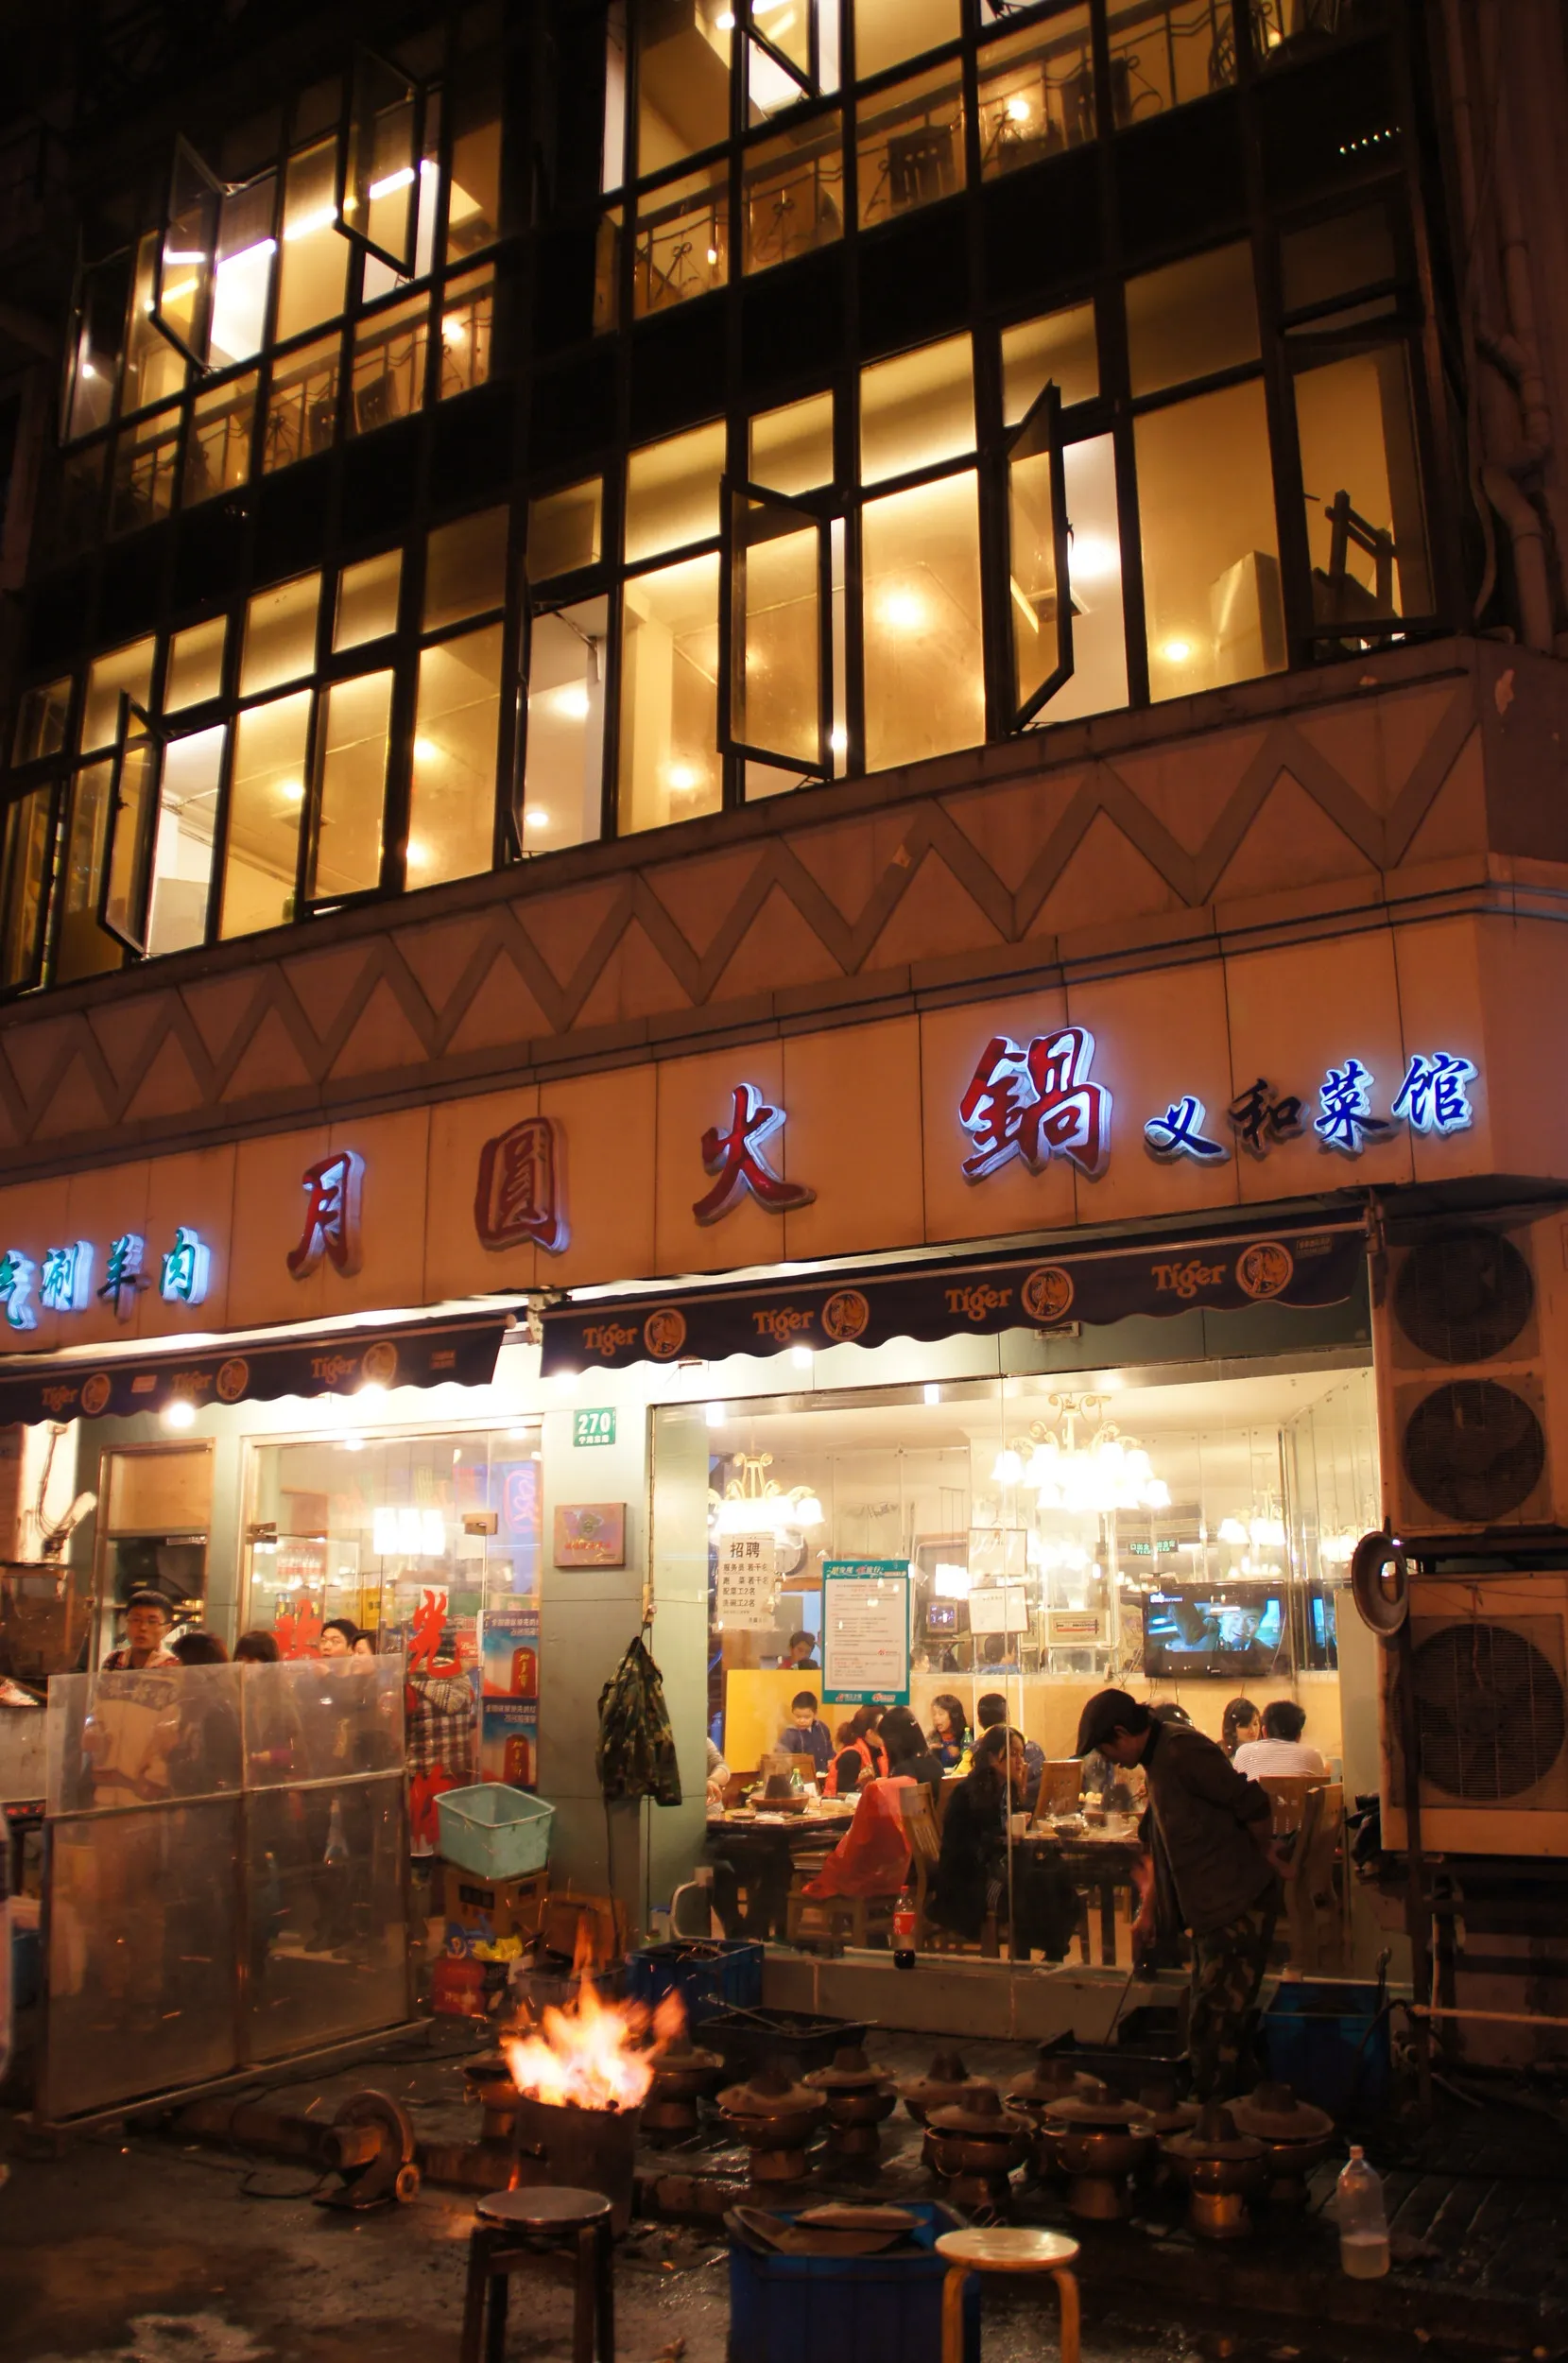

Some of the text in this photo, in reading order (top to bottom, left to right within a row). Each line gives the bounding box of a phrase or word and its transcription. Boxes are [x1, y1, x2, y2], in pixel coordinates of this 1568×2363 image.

[1145, 1051, 1478, 1163] 义和菜馆
[1151, 1258, 1226, 1299] Tiger
[946, 1283, 1012, 1322] Tiger
[582, 1322, 638, 1358] Tiger
[753, 1308, 814, 1342] Tiger
[311, 1353, 357, 1384] Tiger
[42, 1385, 78, 1412] Tiger
[578, 1412, 611, 1434] 270
[730, 1542, 760, 1558] 招聘
